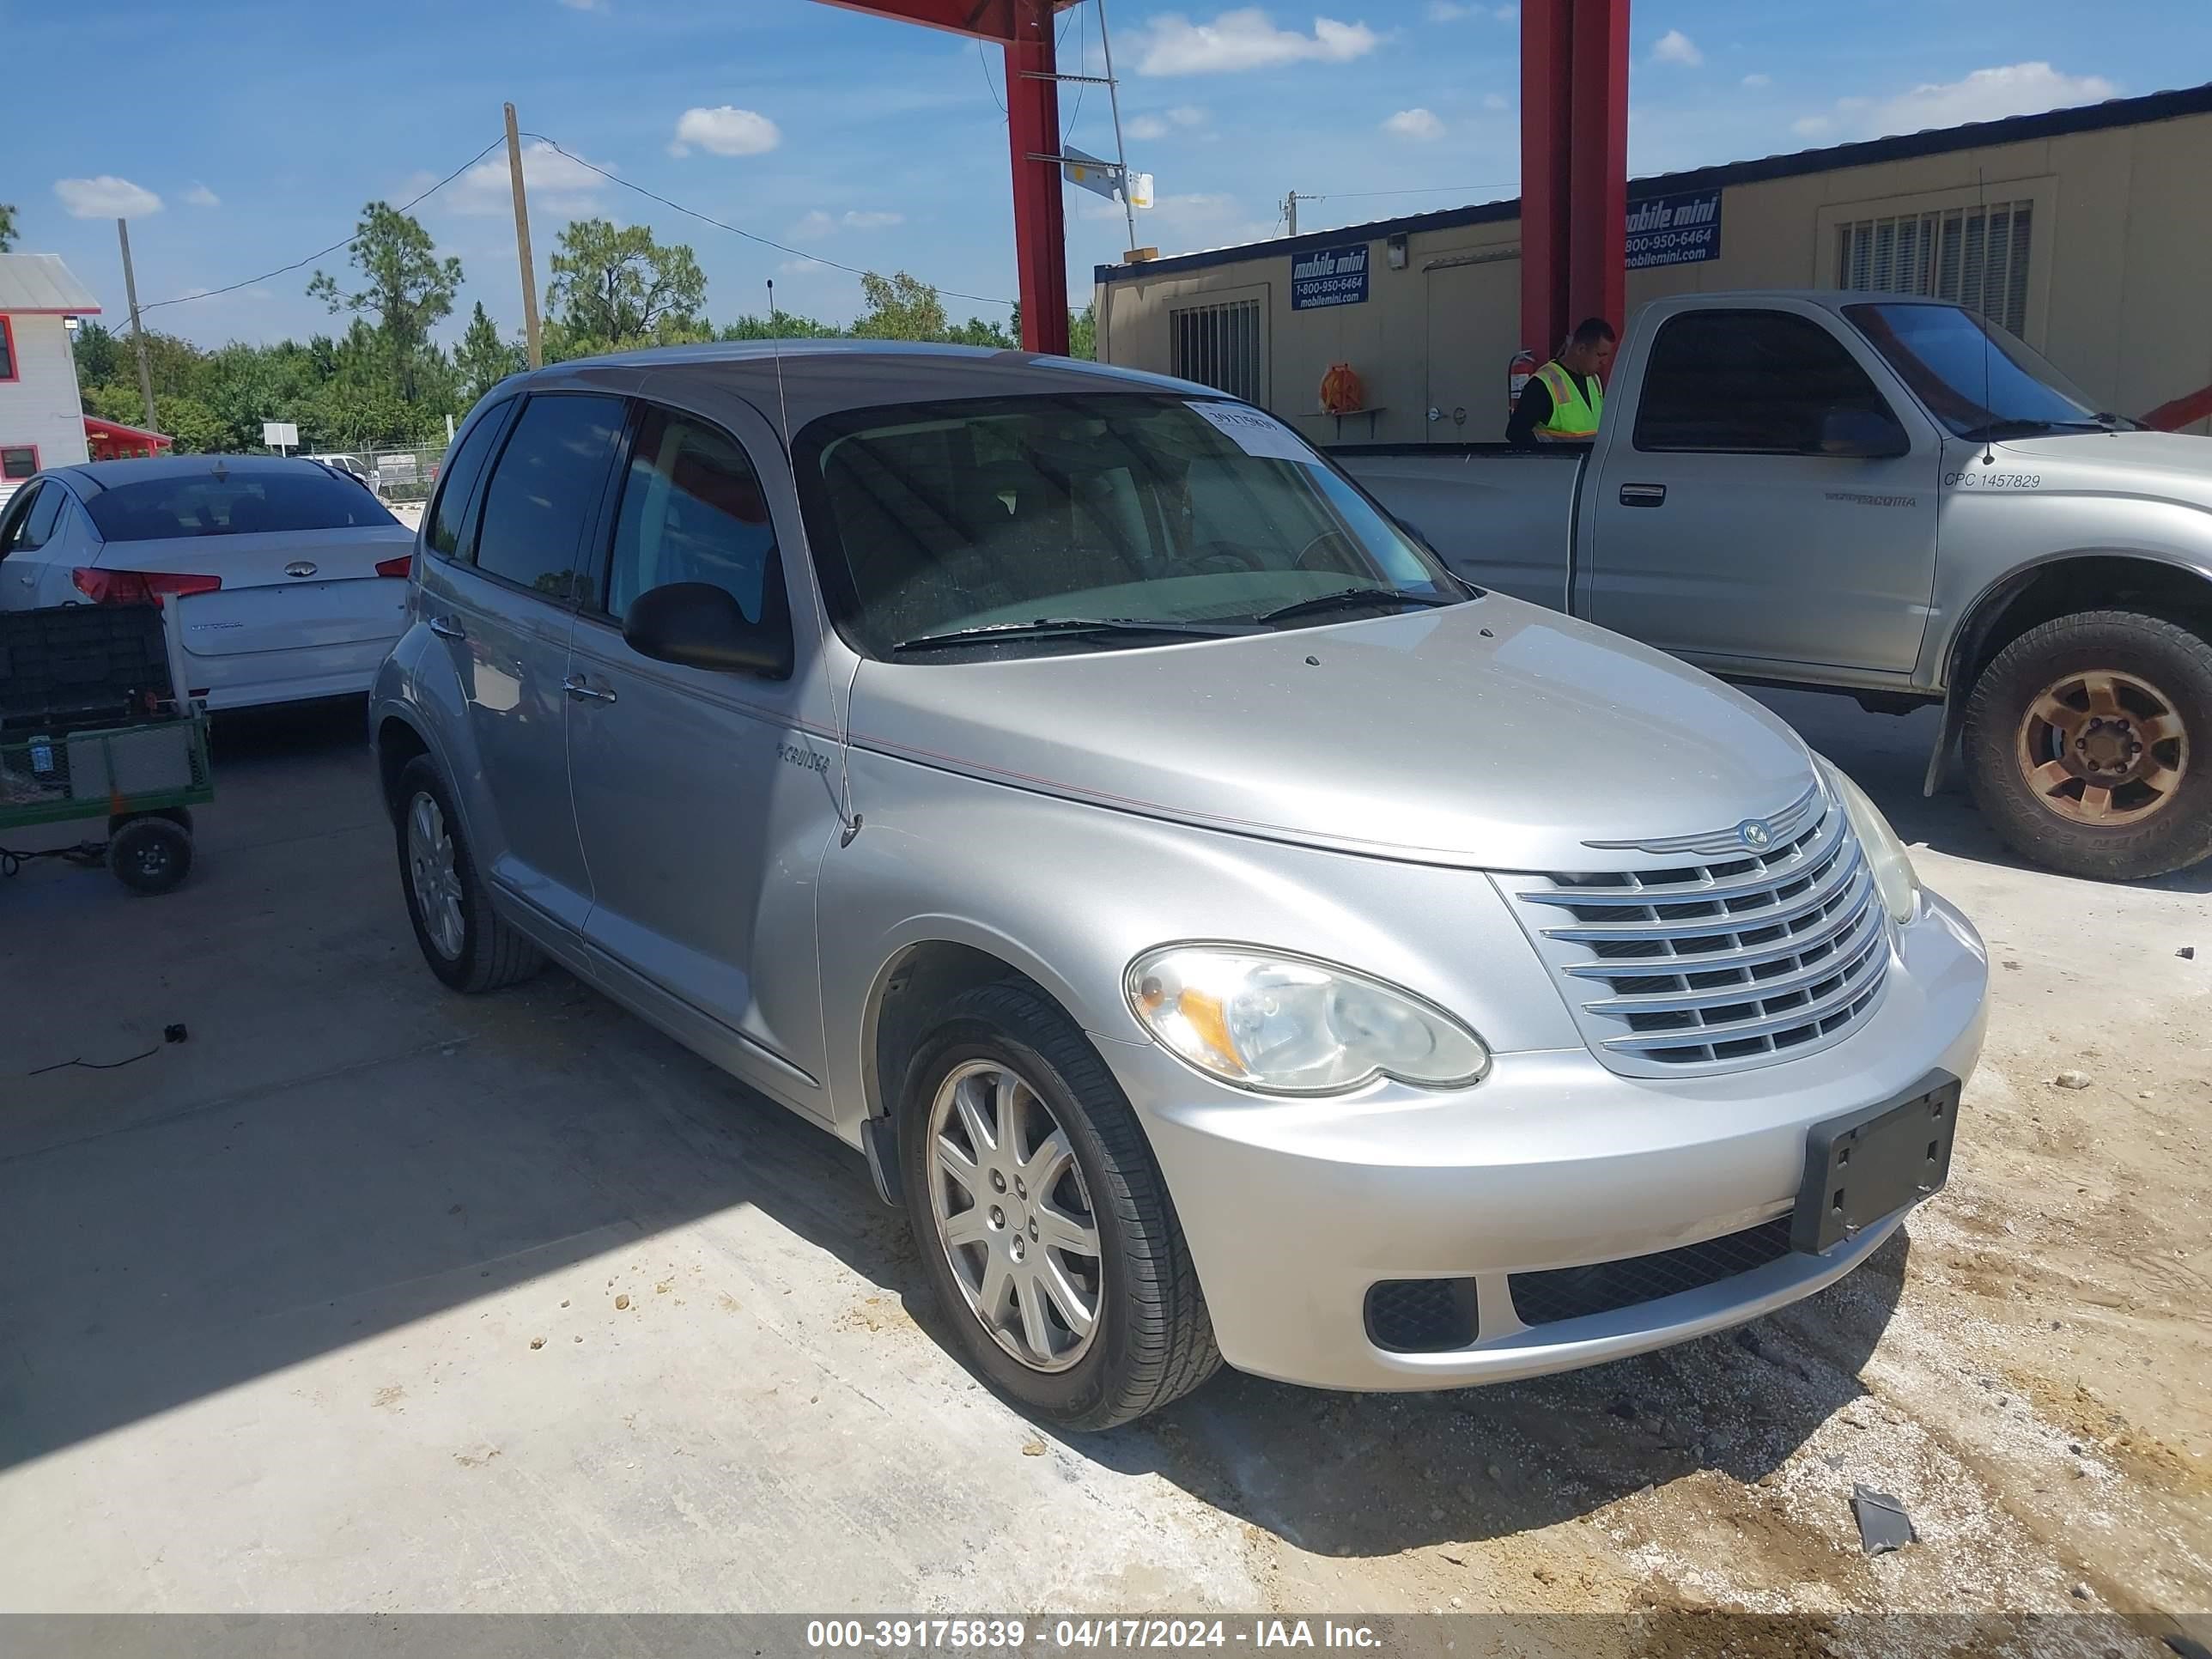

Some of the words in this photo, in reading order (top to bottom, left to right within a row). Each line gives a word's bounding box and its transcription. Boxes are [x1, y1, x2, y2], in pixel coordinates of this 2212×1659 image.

[1626, 200, 1672, 232] obile
[1673, 196, 1718, 226] mini
[1294, 252, 1335, 279] mobile
[1336, 250, 1367, 274] mini
[1296, 276, 1363, 295] 1-800-950-6464
[1300, 293, 1359, 308] mobilemini.com
[1209, 411, 1278, 431] 39175839
[1944, 472, 1977, 487] CPC
[1981, 474, 2040, 488] 1457829
[784, 745, 832, 774] CRUISER
